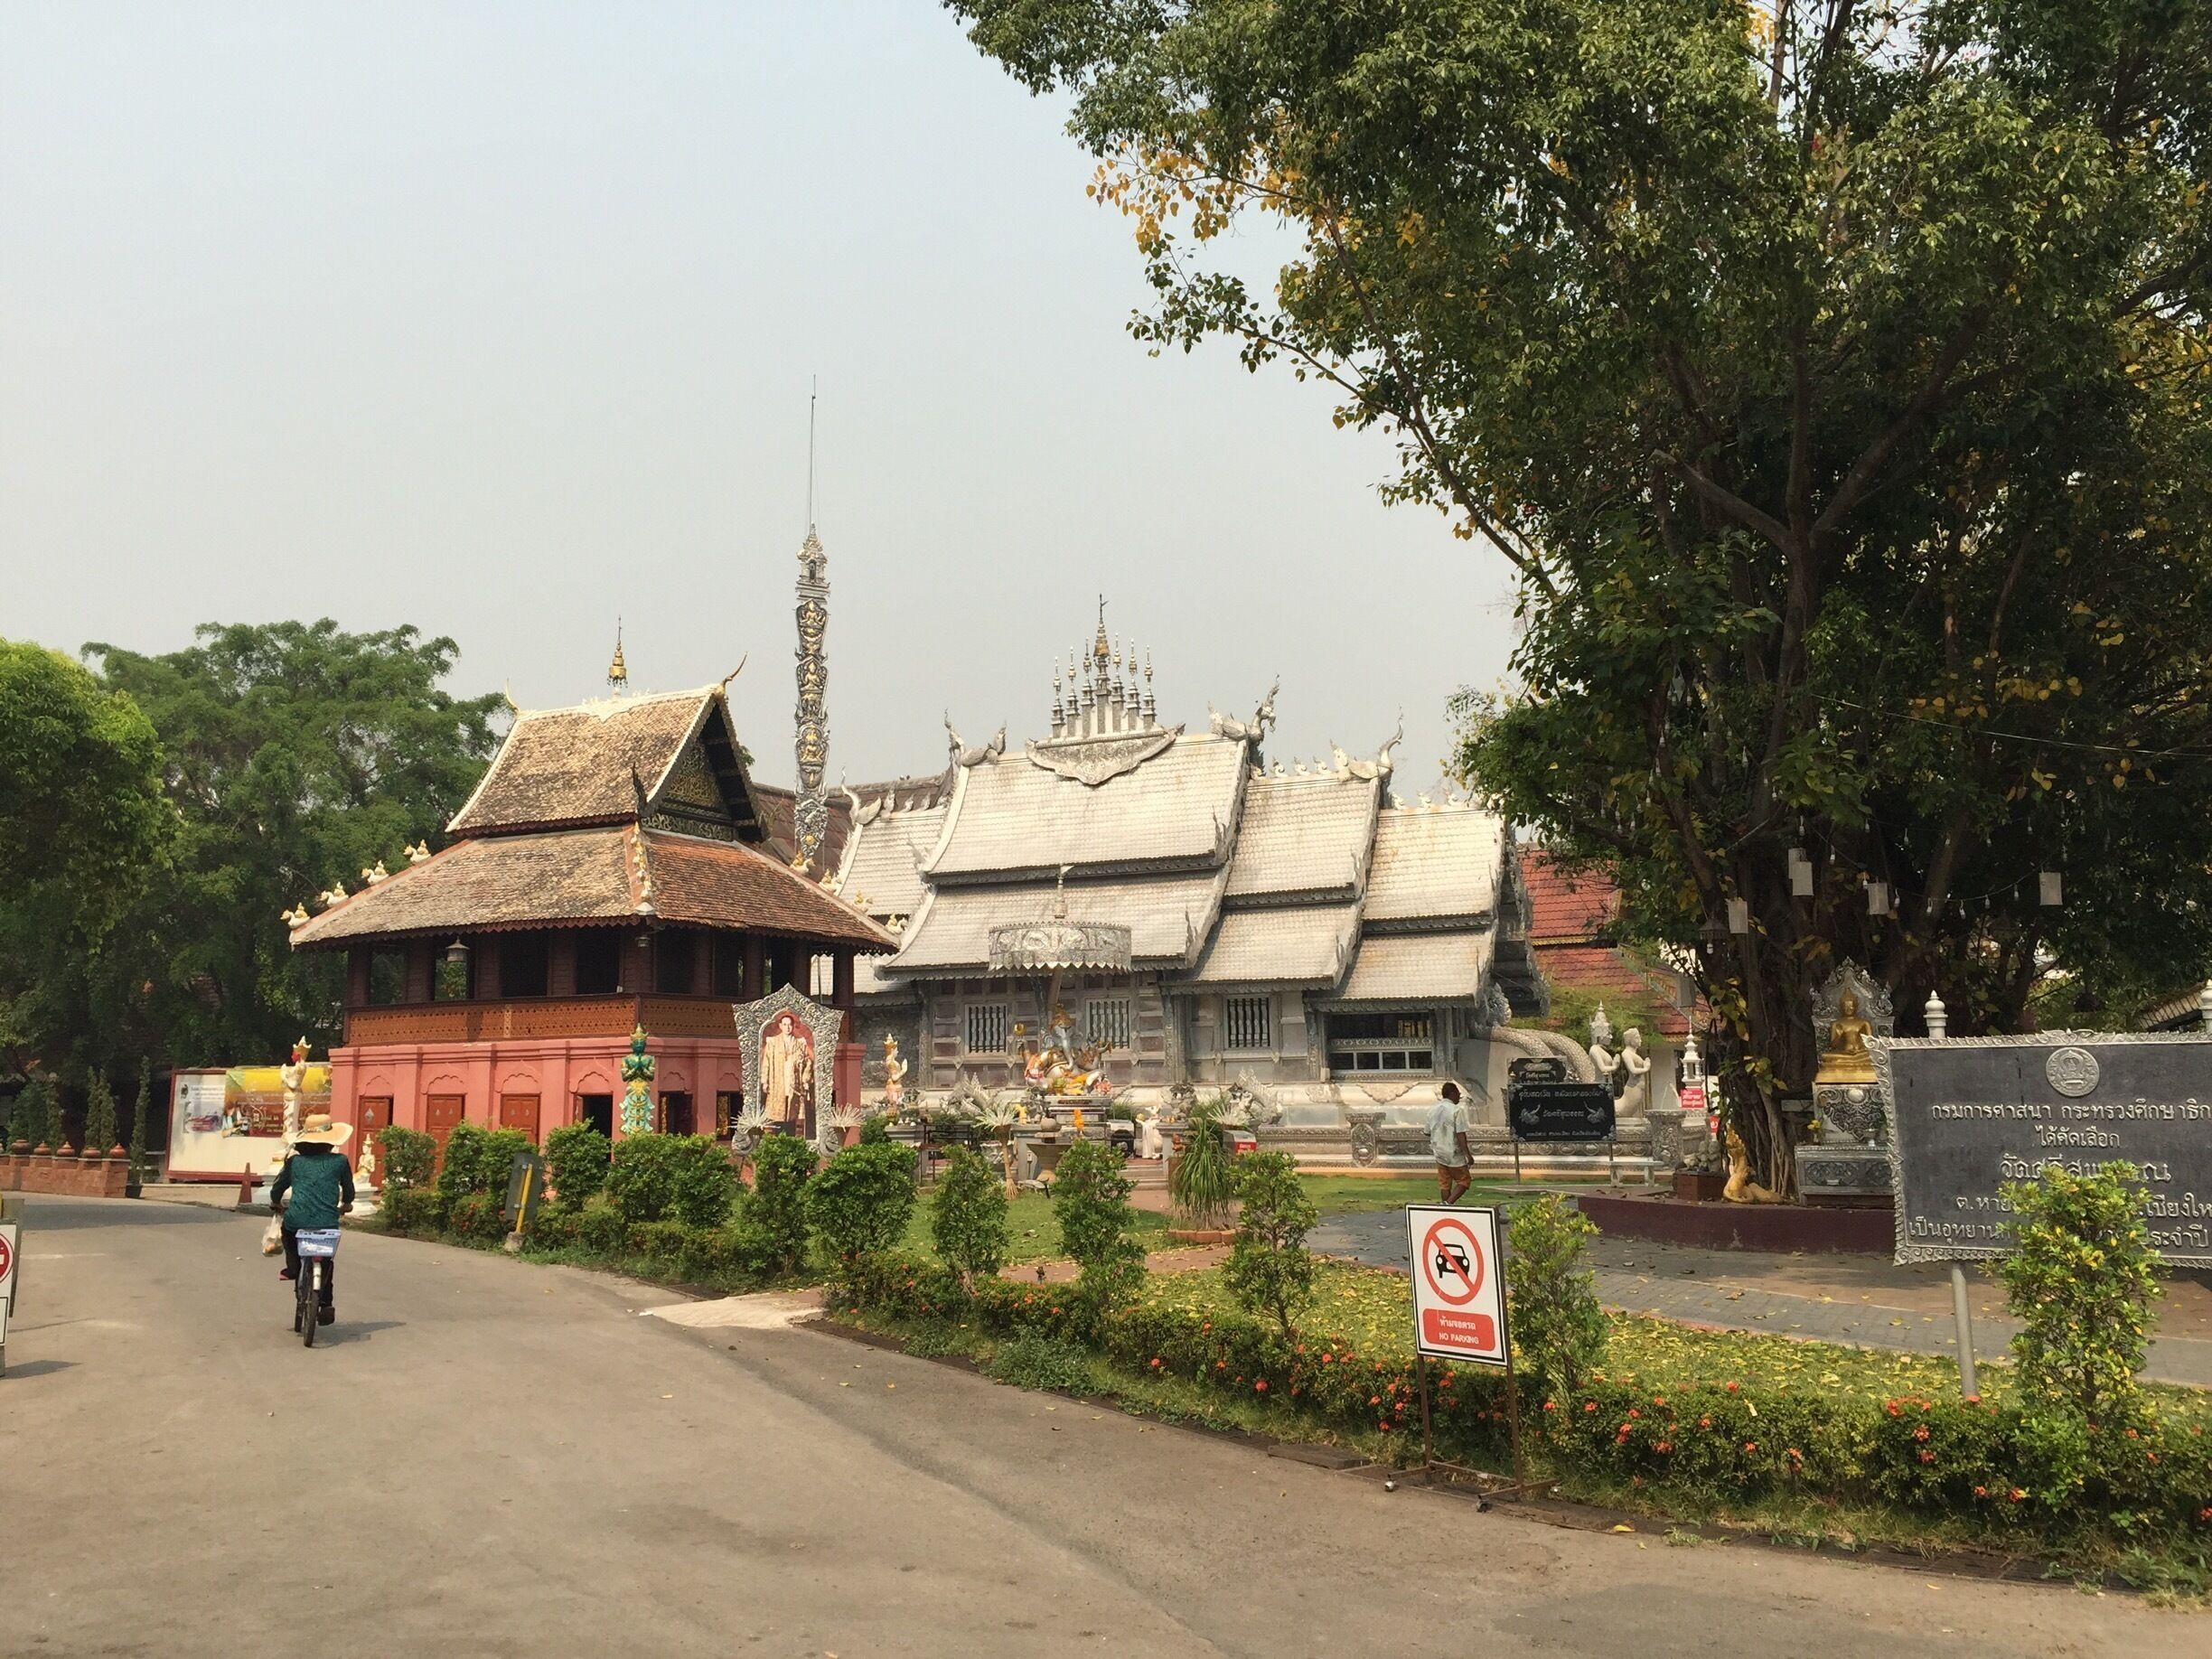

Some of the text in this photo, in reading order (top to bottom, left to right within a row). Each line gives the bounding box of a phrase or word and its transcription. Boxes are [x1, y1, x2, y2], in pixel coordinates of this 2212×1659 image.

[1932, 1103, 2052, 1120] กรมการศาสนา
[2035, 1124, 2121, 1148] ได้คัดเลือก
[1439, 1333, 1479, 1345] NO PARKING
